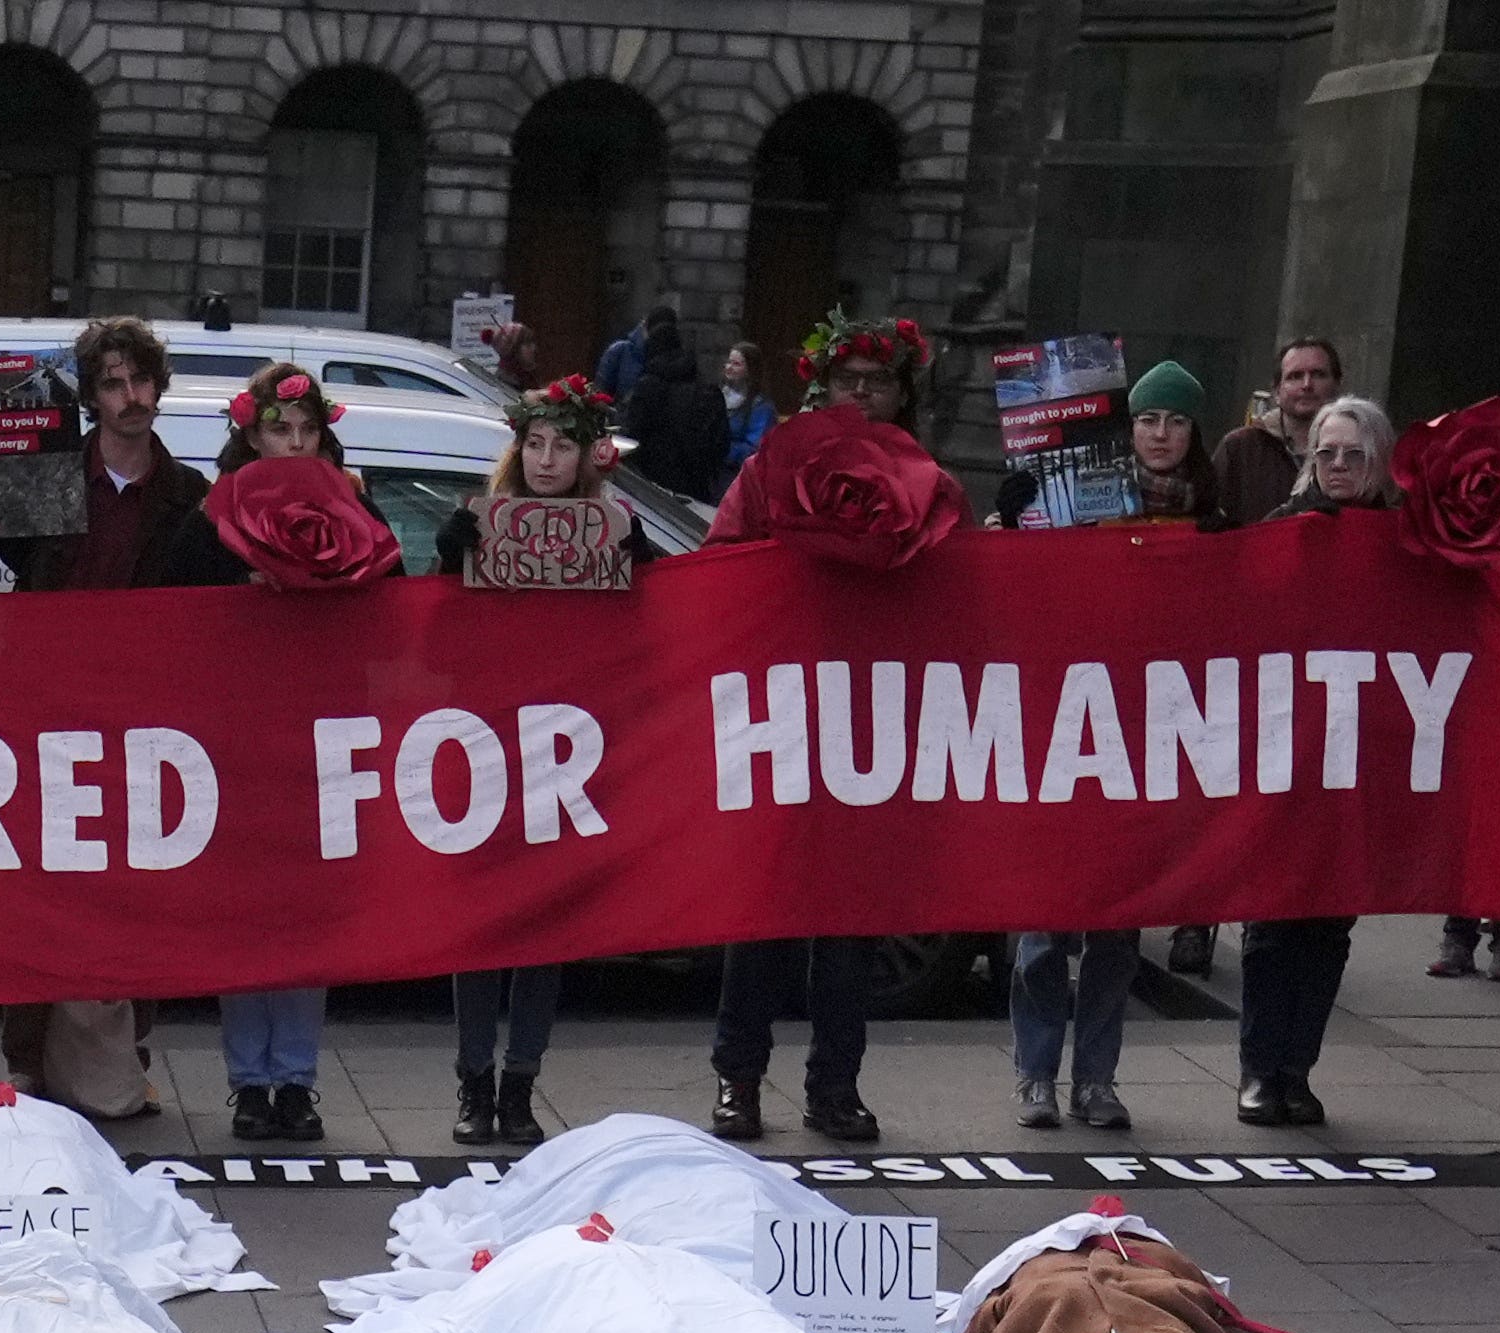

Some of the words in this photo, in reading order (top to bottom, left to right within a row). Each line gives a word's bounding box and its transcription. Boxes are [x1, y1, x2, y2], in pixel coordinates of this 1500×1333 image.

[994, 351, 1034, 364] Flooding
[1, 417, 13, 427] to
[15, 418, 34, 430] you
[36, 415, 50, 428] by
[1003, 410, 1046, 427] Brought
[1048, 409, 1059, 419] to
[1061, 406, 1082, 419] you
[1083, 402, 1097, 415] by
[1007, 433, 1049, 450] Equinor
[313, 703, 609, 861] FOR
[710, 650, 1473, 812] HUMANITY
[1084, 1156, 1438, 1182] FUELS
[765, 1219, 933, 1301] SUICIDE
